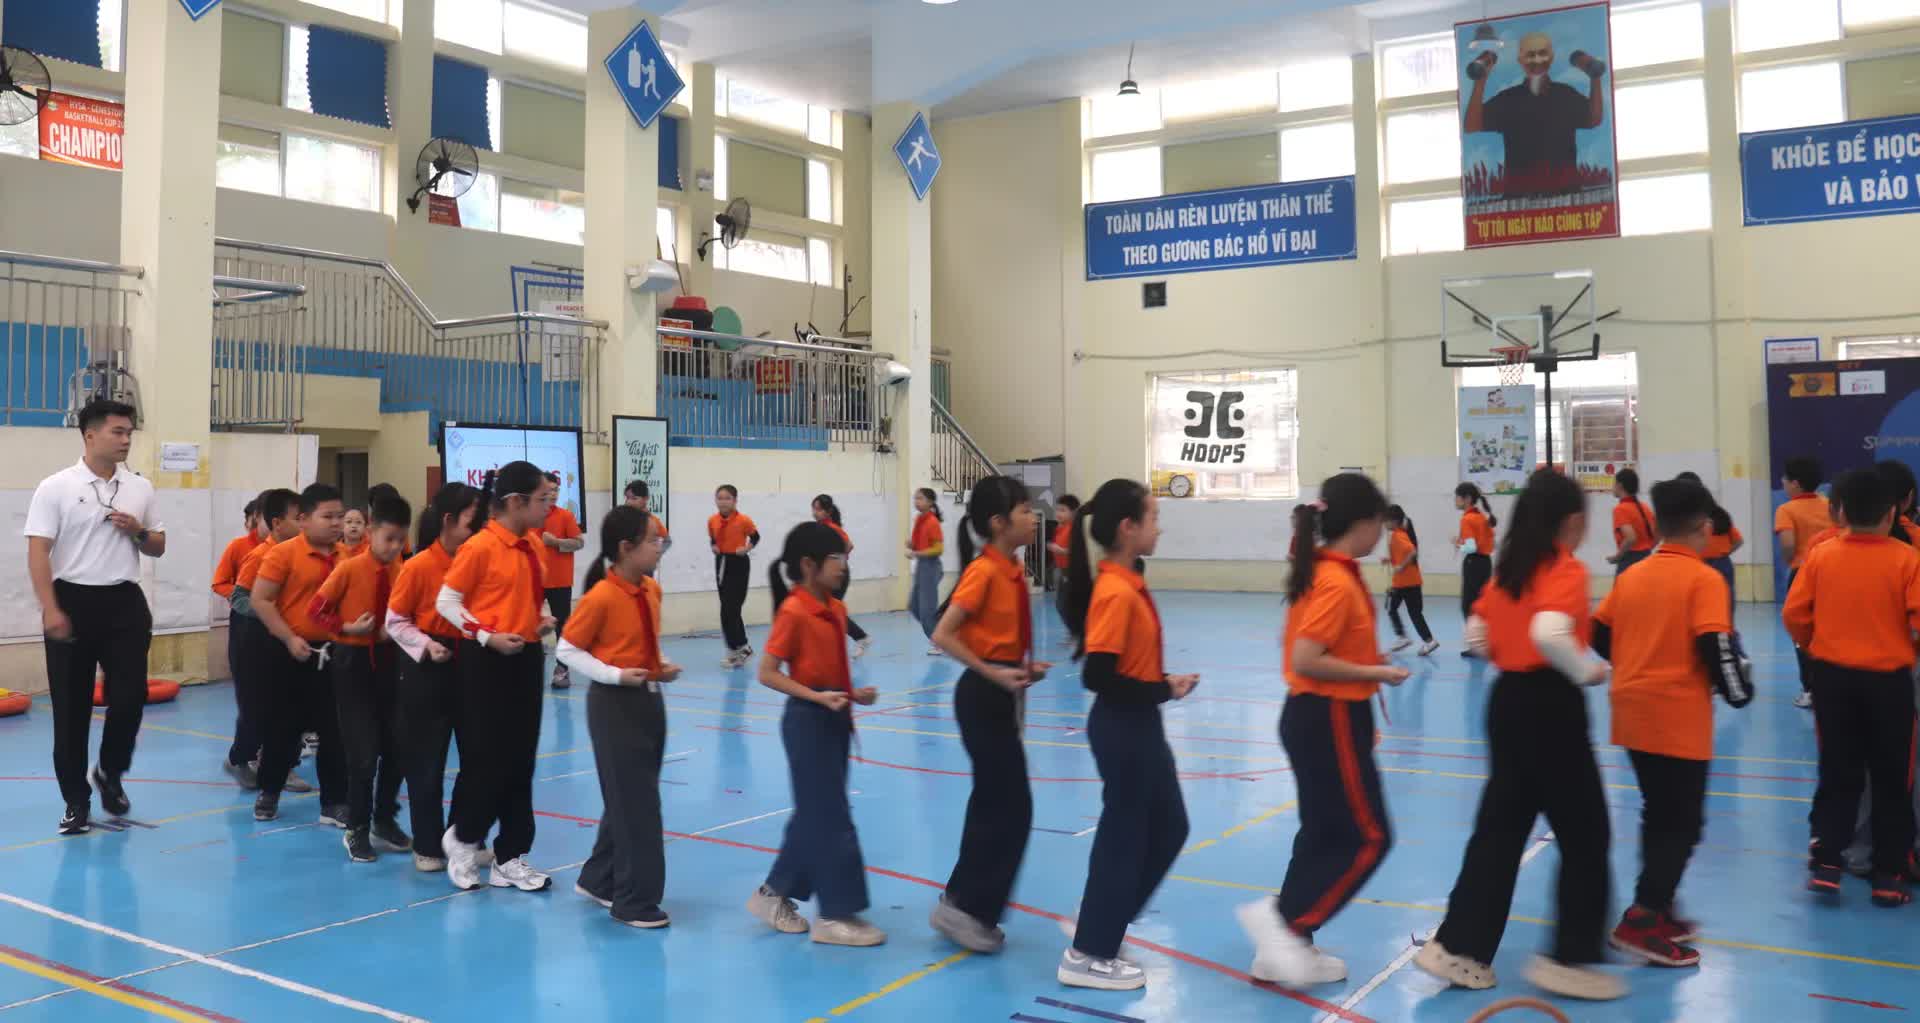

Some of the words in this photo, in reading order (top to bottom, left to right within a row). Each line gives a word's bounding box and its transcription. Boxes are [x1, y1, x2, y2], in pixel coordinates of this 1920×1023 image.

[64, 111, 104, 125] BASKETBALL
[49, 122, 122, 163] CHAMPIO
[1771, 136, 1831, 171] KHỎE
[1836, 128, 1867, 164] ĐỂ
[1874, 132, 1920, 164] HỌC
[1824, 176, 1855, 206] VÀ
[1860, 169, 1908, 203] BẢO
[1105, 209, 1141, 235] TOÀN
[1145, 207, 1174, 232] DÂN
[1178, 204, 1207, 228] RÈN
[1211, 198, 1257, 226] LUYỆN
[1261, 193, 1300, 219] THÂN
[1305, 184, 1334, 214] THỂ
[1123, 245, 1157, 266] THEO
[1161, 239, 1210, 263] GƯƠNG
[1214, 233, 1244, 258] BÁC
[1248, 228, 1267, 255] HỒ
[1272, 228, 1287, 252] VĨ
[1290, 229, 1317, 255] ĐẠI
[1180, 442, 1246, 463] HOOPS
